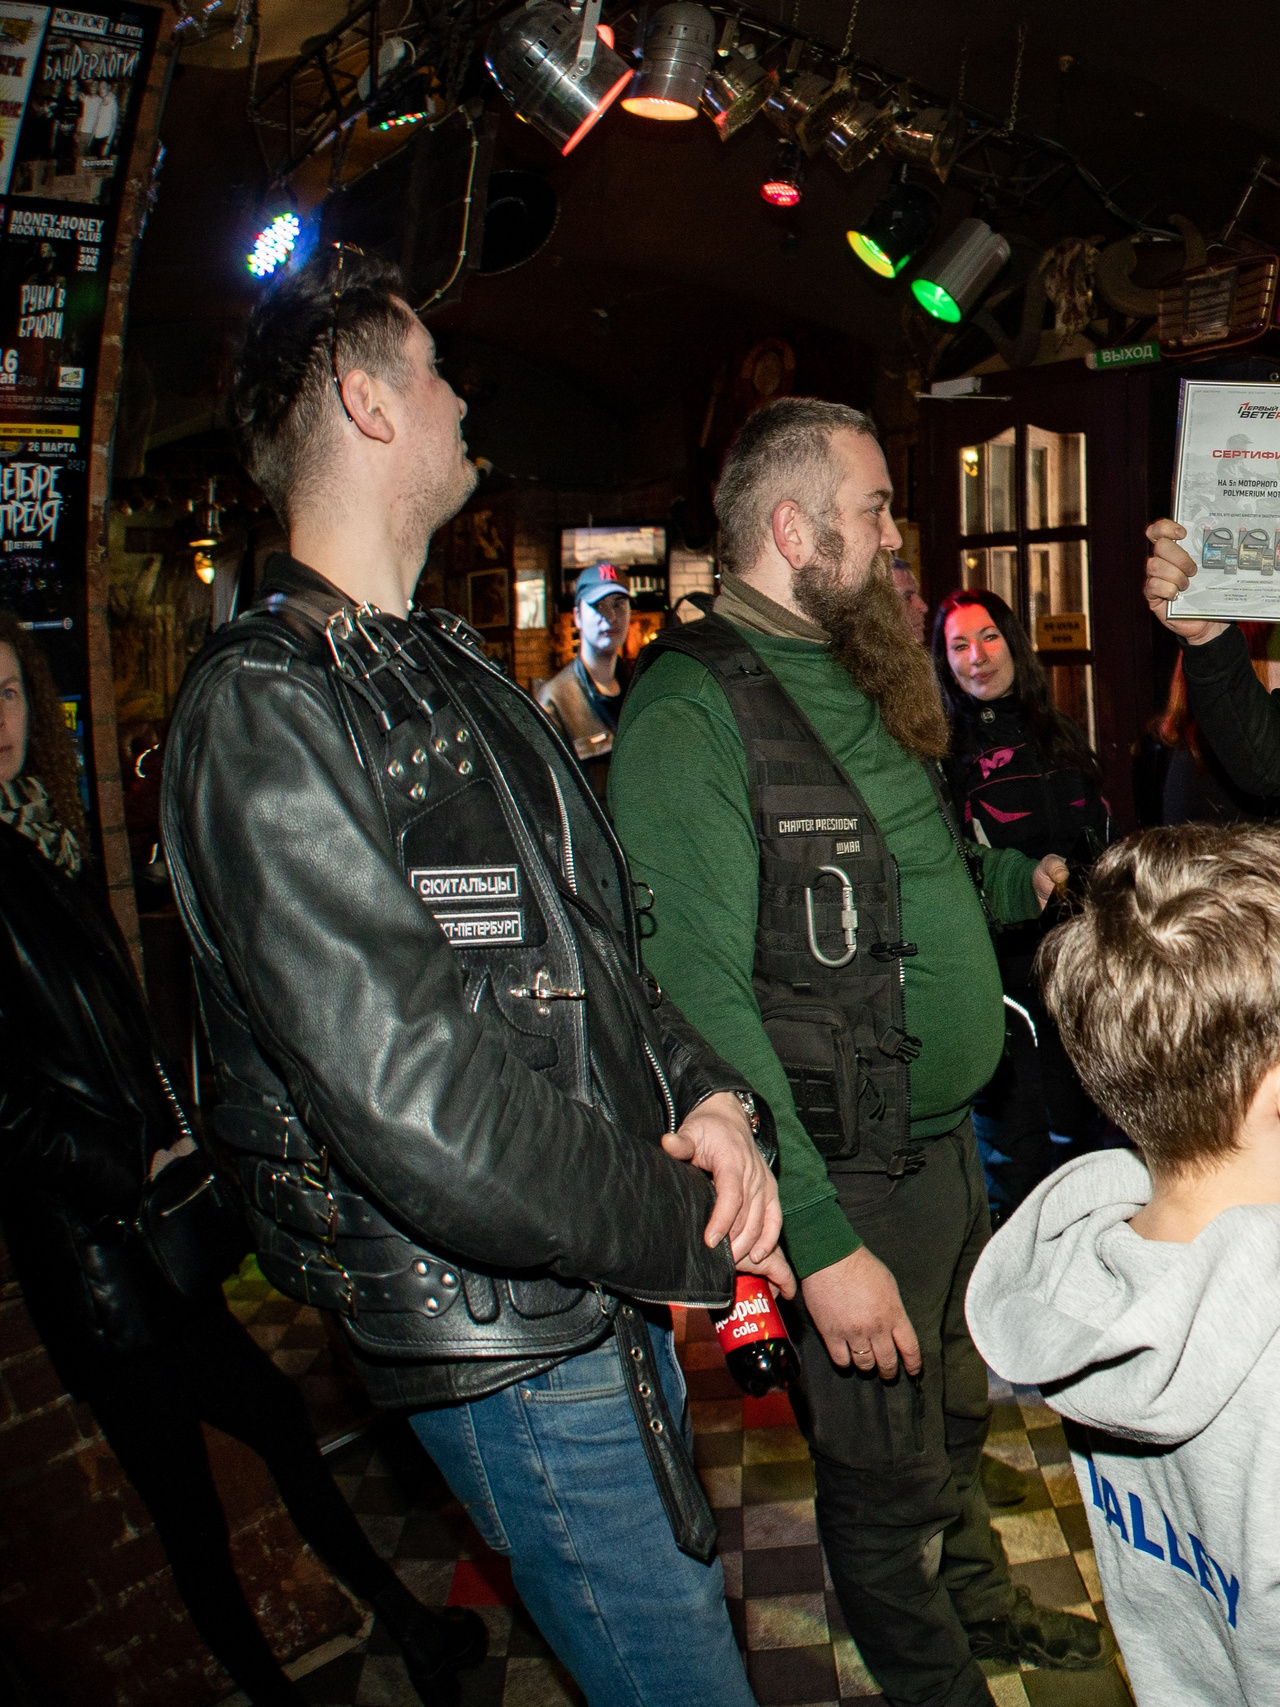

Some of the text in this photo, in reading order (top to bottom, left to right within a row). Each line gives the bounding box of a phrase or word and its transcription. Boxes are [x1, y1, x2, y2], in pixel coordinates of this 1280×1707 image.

[10, 210, 104, 232] MONEY-HONEY
[75, 231, 102, 243] CLUB
[78, 255, 98, 266] 300
[1102, 345, 1153, 363] ВЫХОД
[28, 442, 41, 452] 26
[41, 442, 77, 453] МАРТА
[0, 462, 65, 501] ЕТЫРЕ
[1217, 479, 1227, 487] НА
[1238, 480, 1278, 488] МОТОРНОГО
[1223, 490, 1266, 498] POLYMERIUM
[778, 818, 858, 833] CHAPTER PRESIDENT
[420, 876, 512, 895] СКИТАЛЬЦЫ
[733, 1322, 759, 1339] cola
